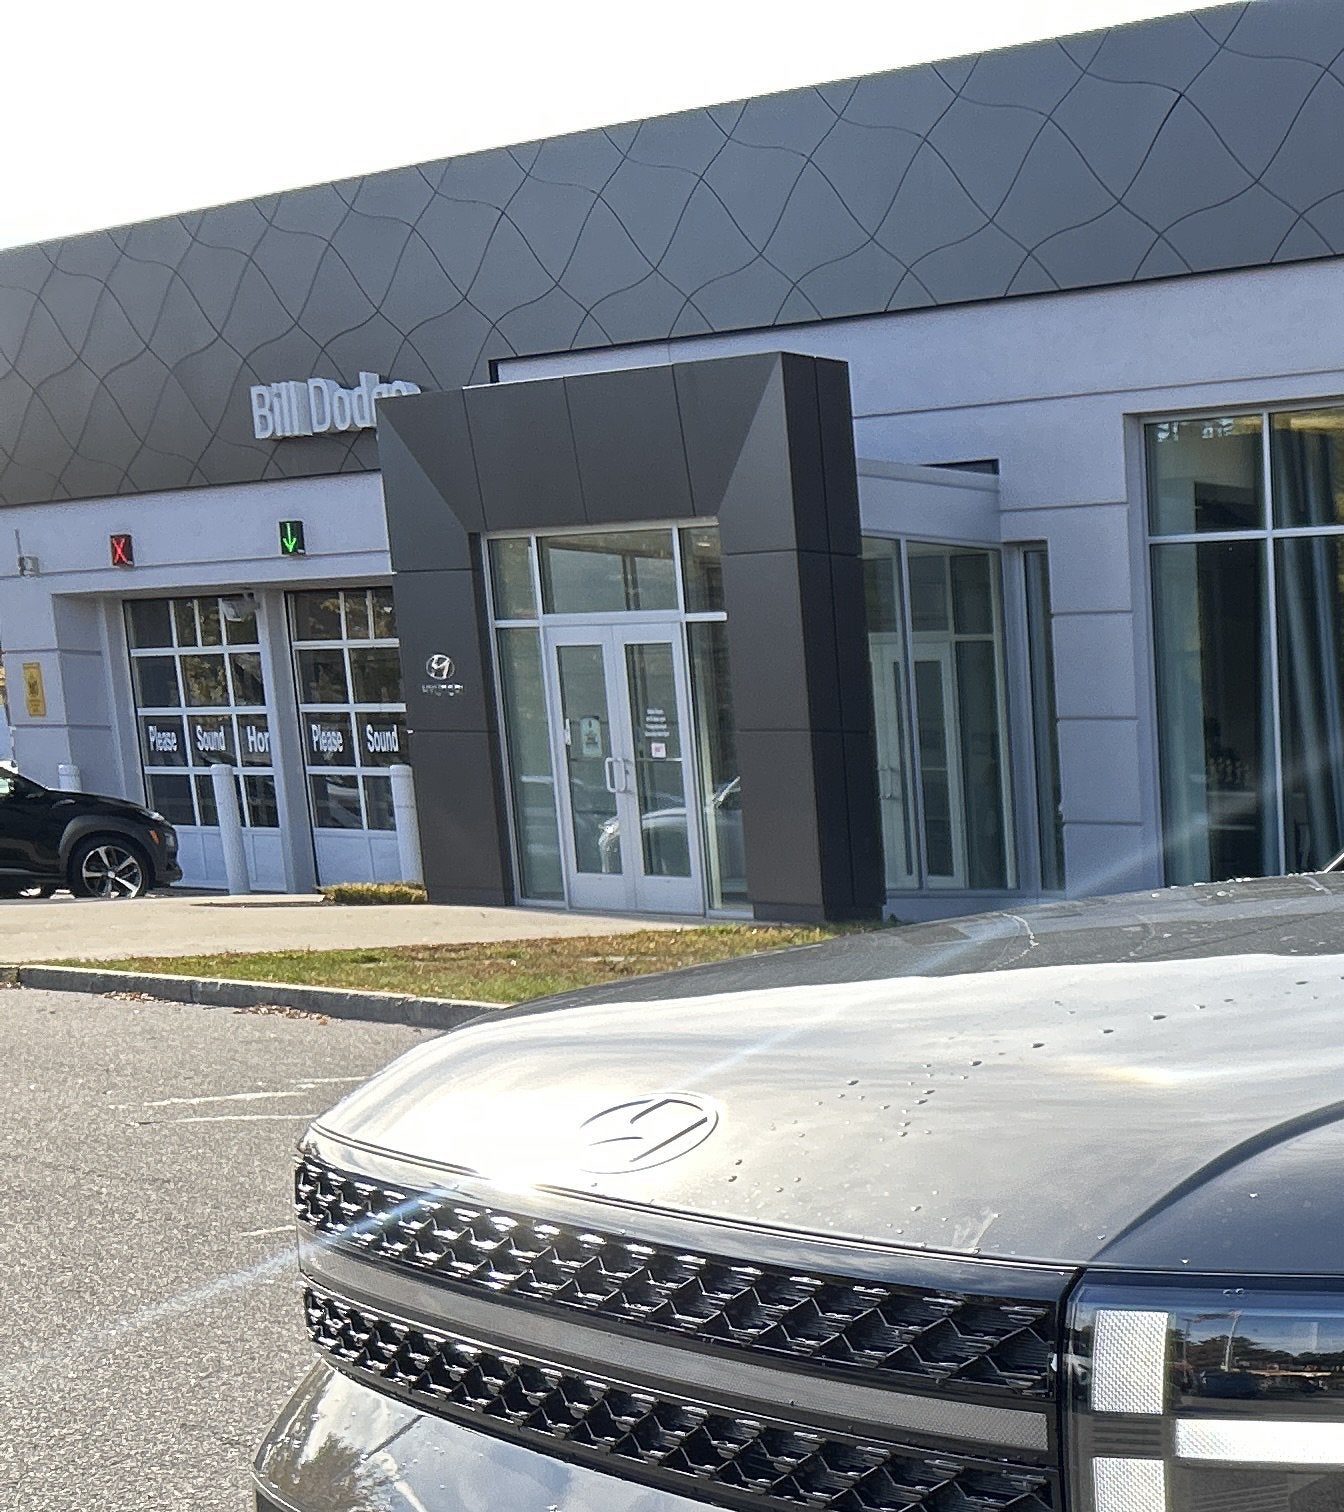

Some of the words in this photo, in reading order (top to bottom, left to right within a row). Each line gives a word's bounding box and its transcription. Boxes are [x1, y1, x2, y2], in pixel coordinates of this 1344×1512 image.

[250, 381, 311, 439] Bill
[307, 371, 421, 433] Dod
[148, 725, 178, 752] Please
[196, 724, 226, 751] Sound
[311, 724, 344, 752] Please
[365, 724, 399, 752] Sound
